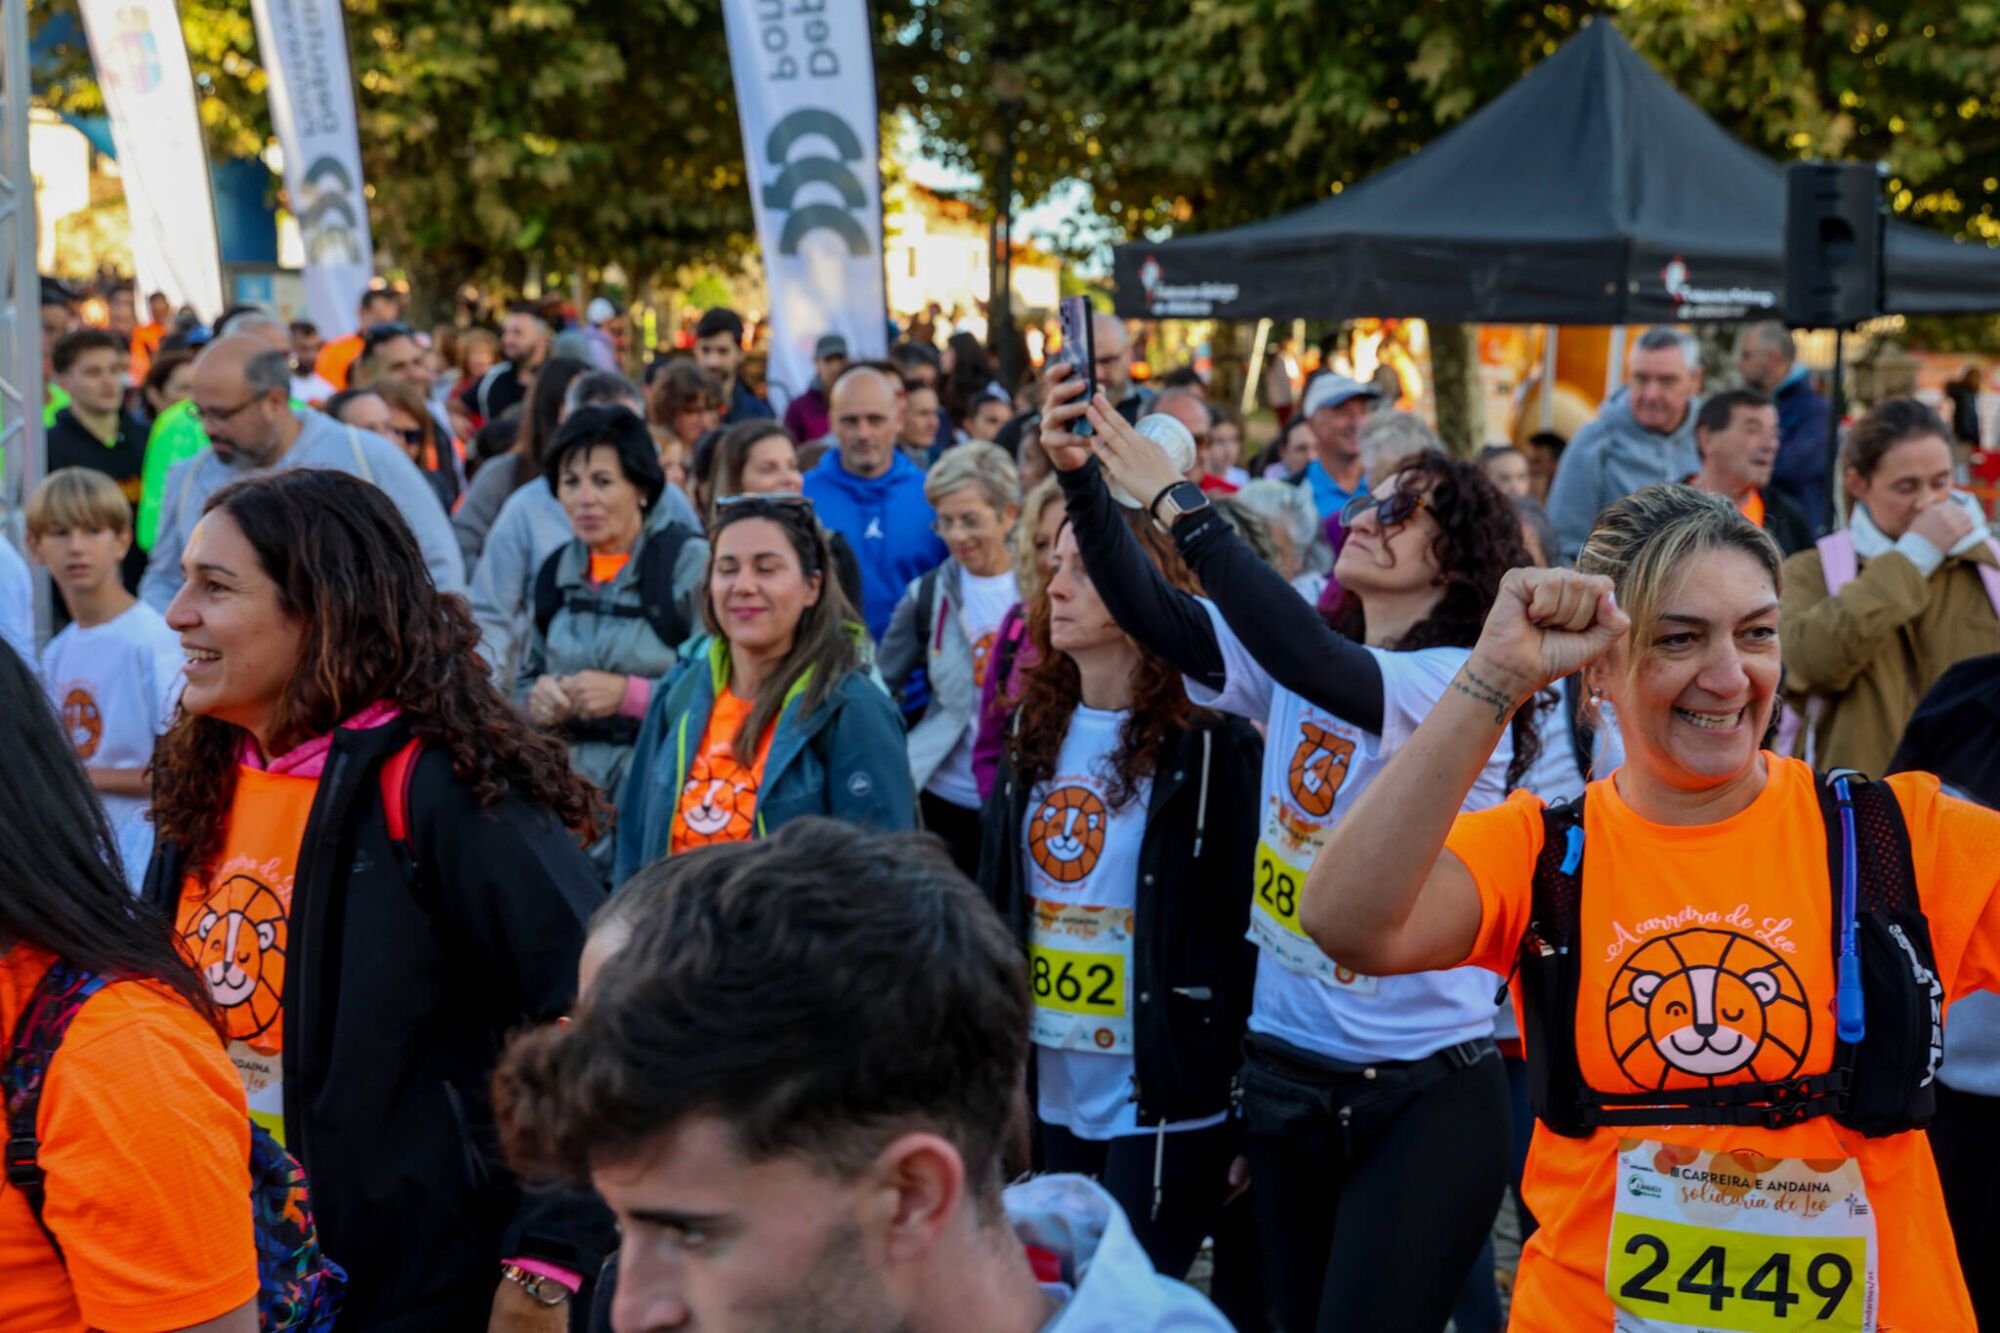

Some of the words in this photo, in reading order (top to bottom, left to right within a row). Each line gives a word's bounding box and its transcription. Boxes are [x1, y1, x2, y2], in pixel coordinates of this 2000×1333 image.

[1260, 859, 1296, 918] 28
[1605, 920, 1642, 962] A
[1636, 905, 1721, 935] carreira
[1724, 904, 1754, 929] de
[1754, 917, 1797, 954] Leo
[1030, 956, 1116, 1006] 862
[1681, 1184, 1770, 1210] solidaria
[1774, 1192, 1797, 1212] de
[1802, 1197, 1831, 1218] Leo
[1682, 1167, 1750, 1189] CARREIRA
[1755, 1179, 1763, 1190] E
[1766, 1180, 1831, 1193] ANDAINA
[1620, 1233, 1853, 1320] 2449
